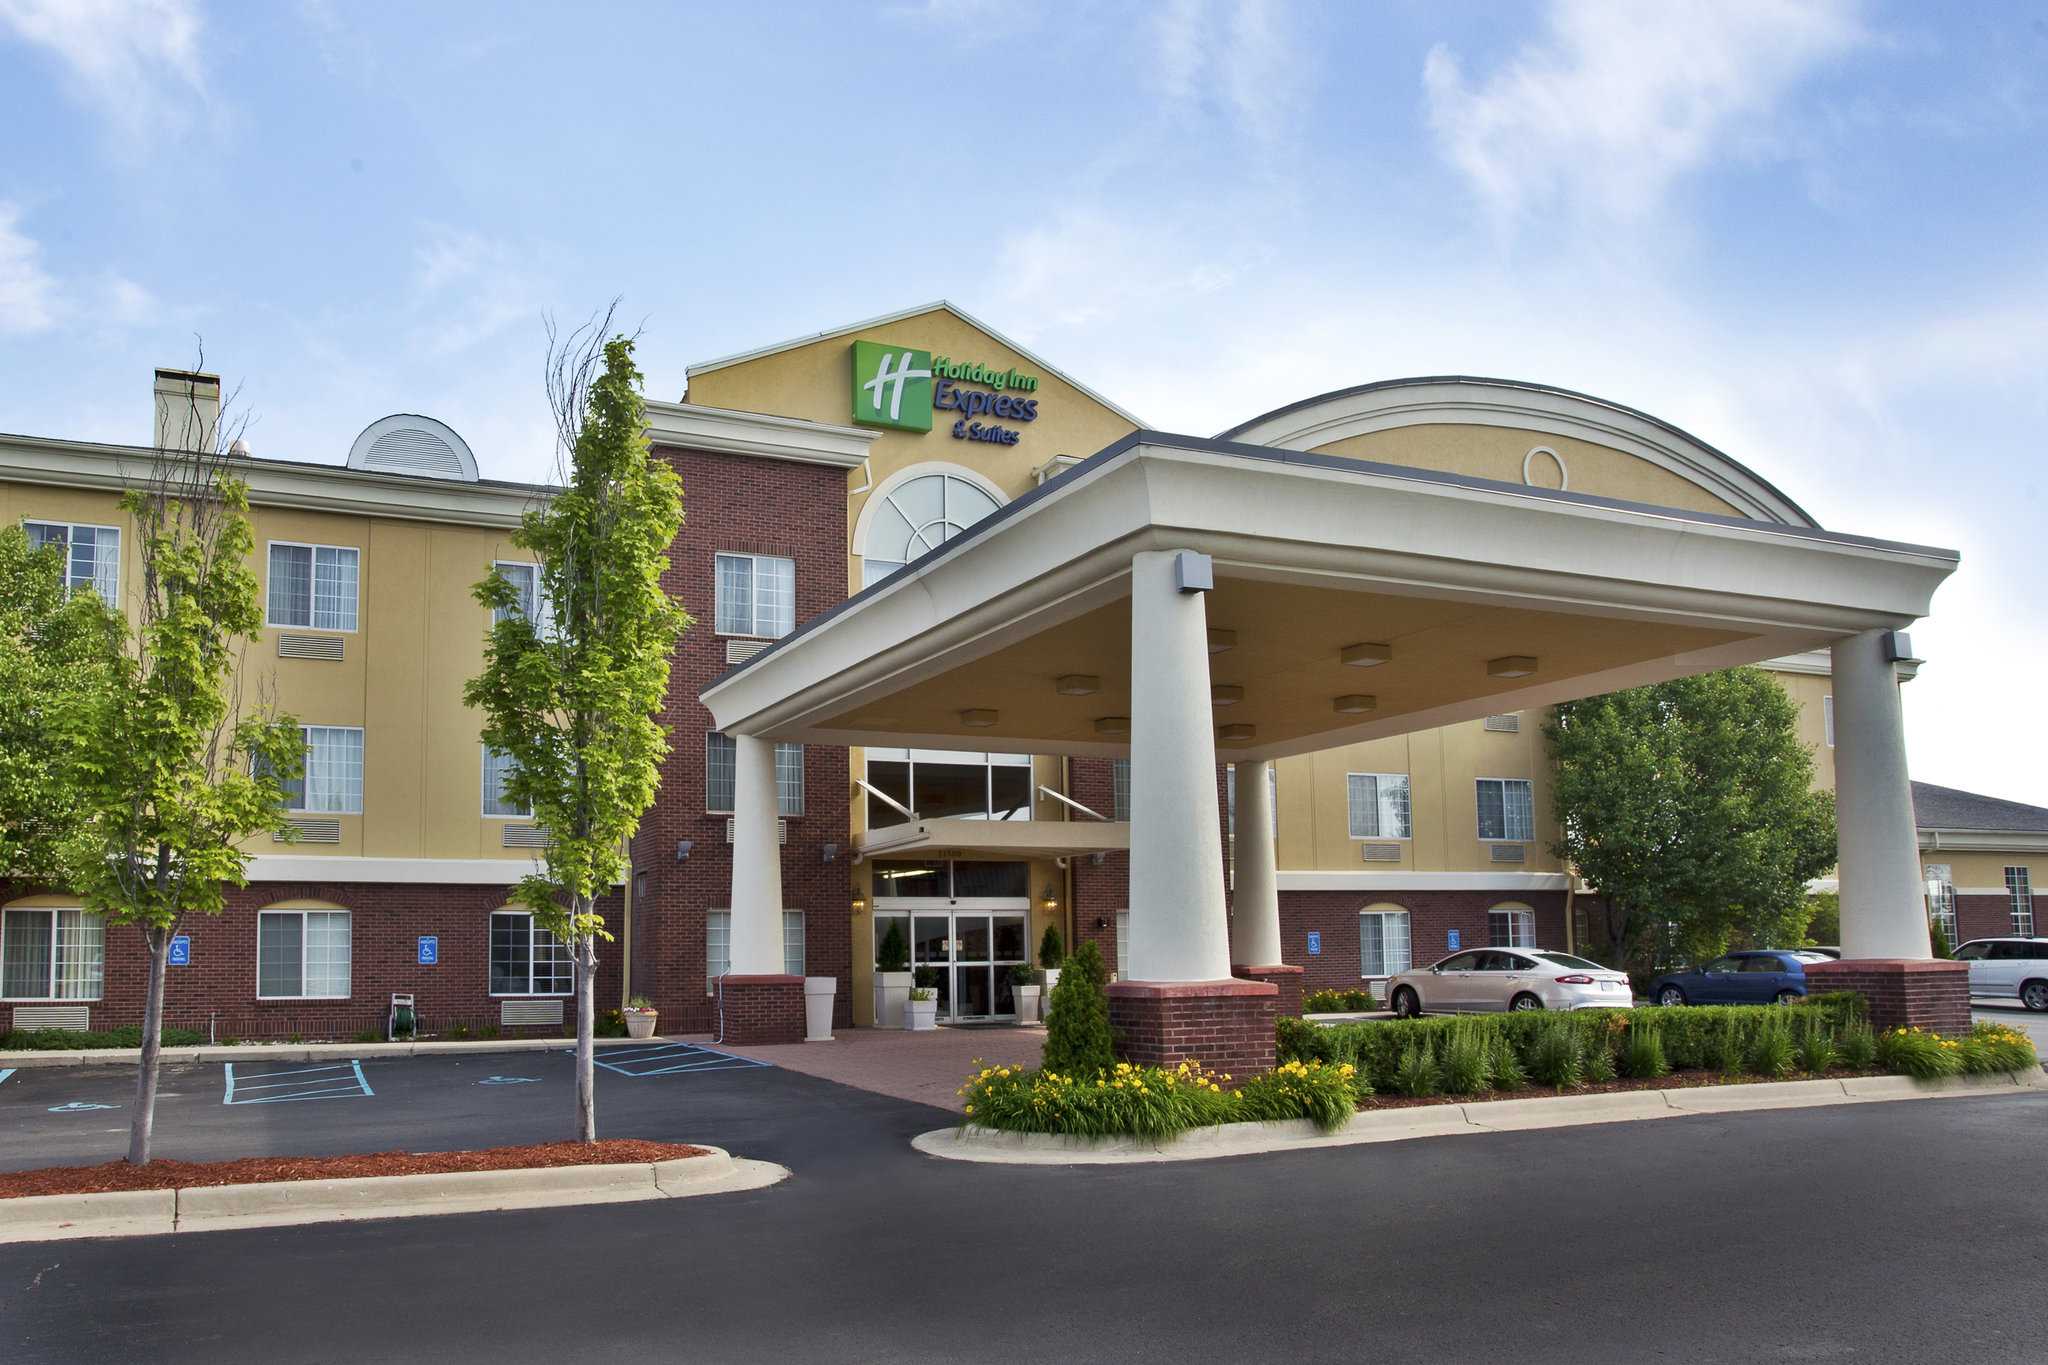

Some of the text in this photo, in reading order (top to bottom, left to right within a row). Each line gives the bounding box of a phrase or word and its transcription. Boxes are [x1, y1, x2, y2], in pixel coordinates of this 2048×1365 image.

[864, 351, 931, 420] H
[933, 356, 1039, 392] Holiday Inn
[934, 379, 1039, 422] Express
[952, 419, 1020, 446] & Suites
